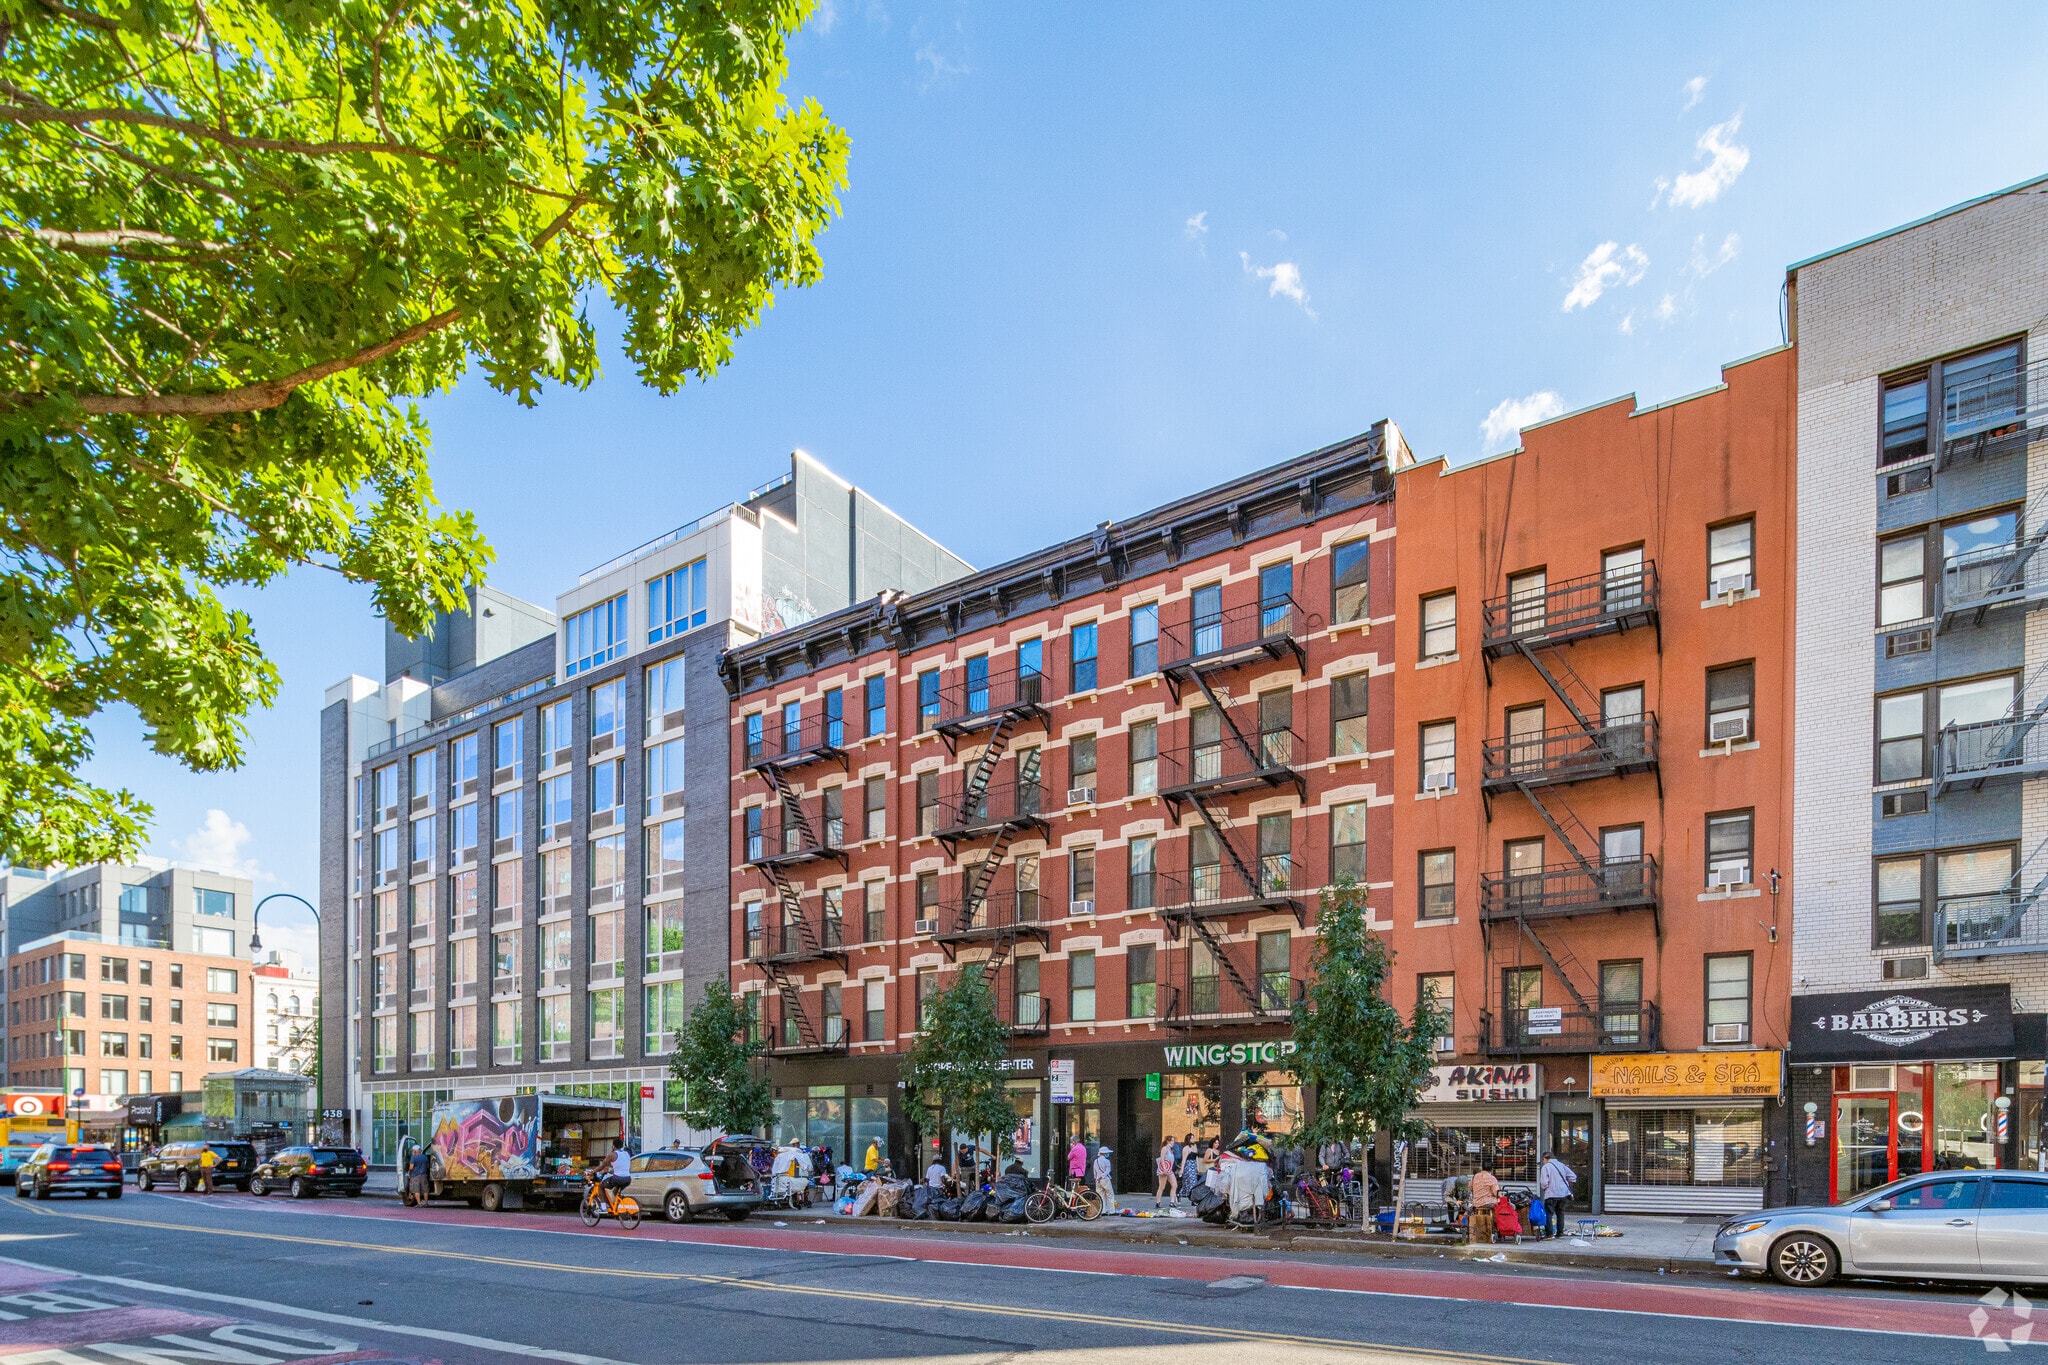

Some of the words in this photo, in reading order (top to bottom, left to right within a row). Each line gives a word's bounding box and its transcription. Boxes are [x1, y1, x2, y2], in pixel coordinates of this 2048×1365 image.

[1830, 1008, 1969, 1031] BARBERS
[1613, 1065, 1679, 1084] NAILS
[1685, 1064, 1706, 1084] &
[1714, 1063, 1760, 1083] SPA
[1456, 1088, 1528, 1100] SUSHI
[322, 1109, 343, 1118] 438
